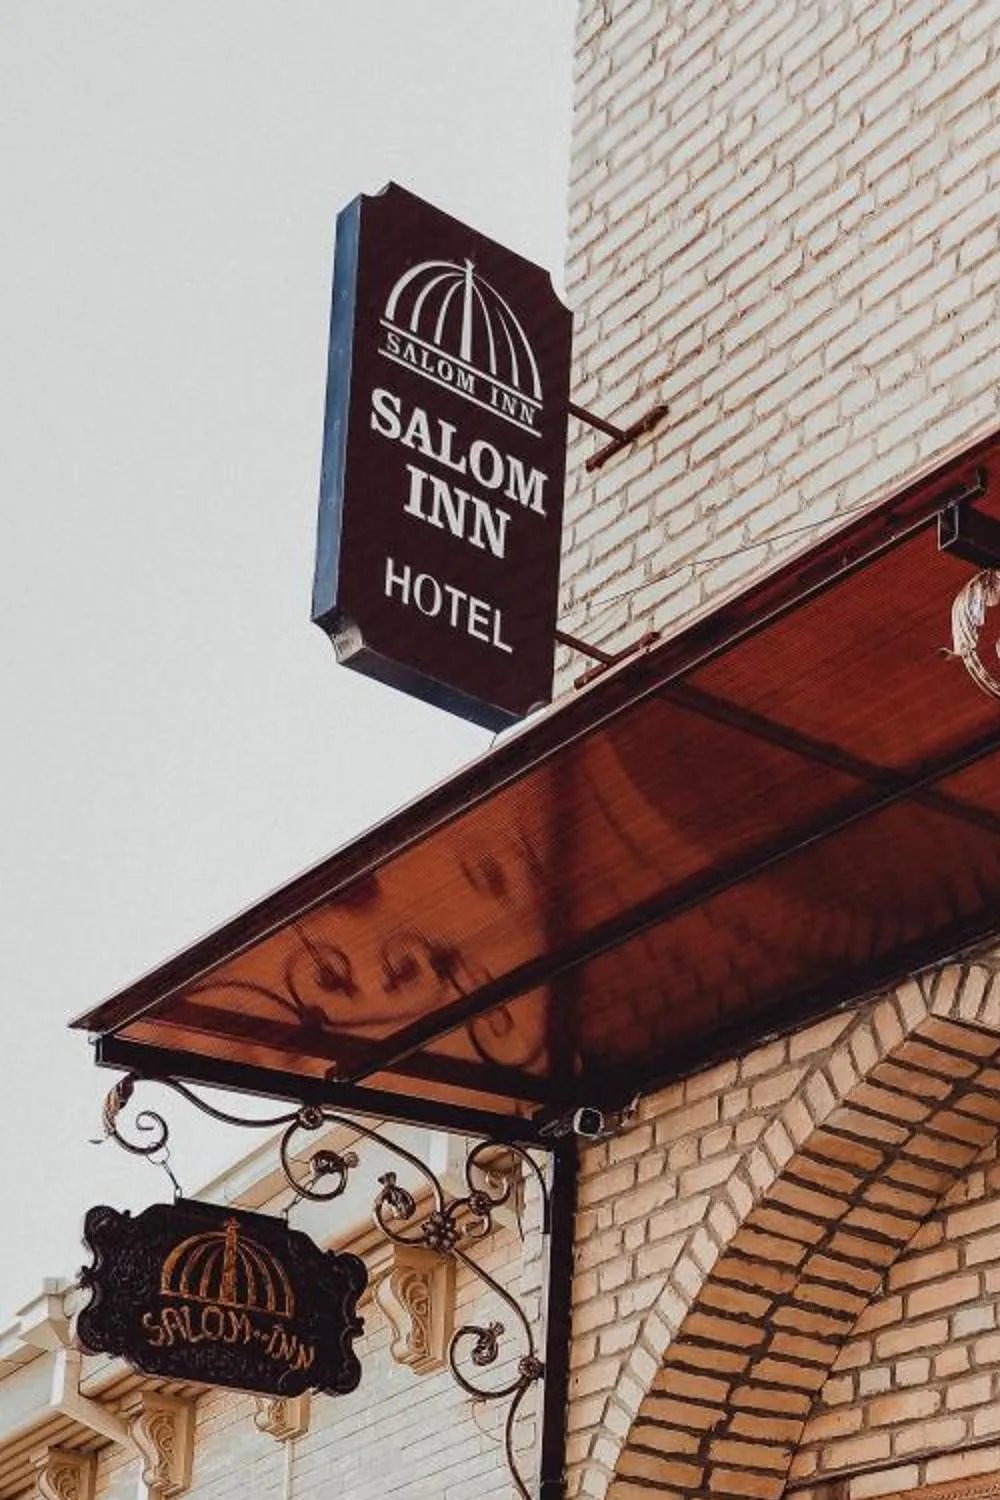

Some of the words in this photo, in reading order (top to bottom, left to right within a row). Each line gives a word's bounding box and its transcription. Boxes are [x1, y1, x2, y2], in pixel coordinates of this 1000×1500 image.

[386, 331, 476, 395] SALOM
[490, 384, 536, 426] INN
[370, 386, 548, 517] SALOM
[403, 463, 512, 560] INN
[384, 556, 514, 654] HOTEL
[142, 1305, 251, 1347] SALOM
